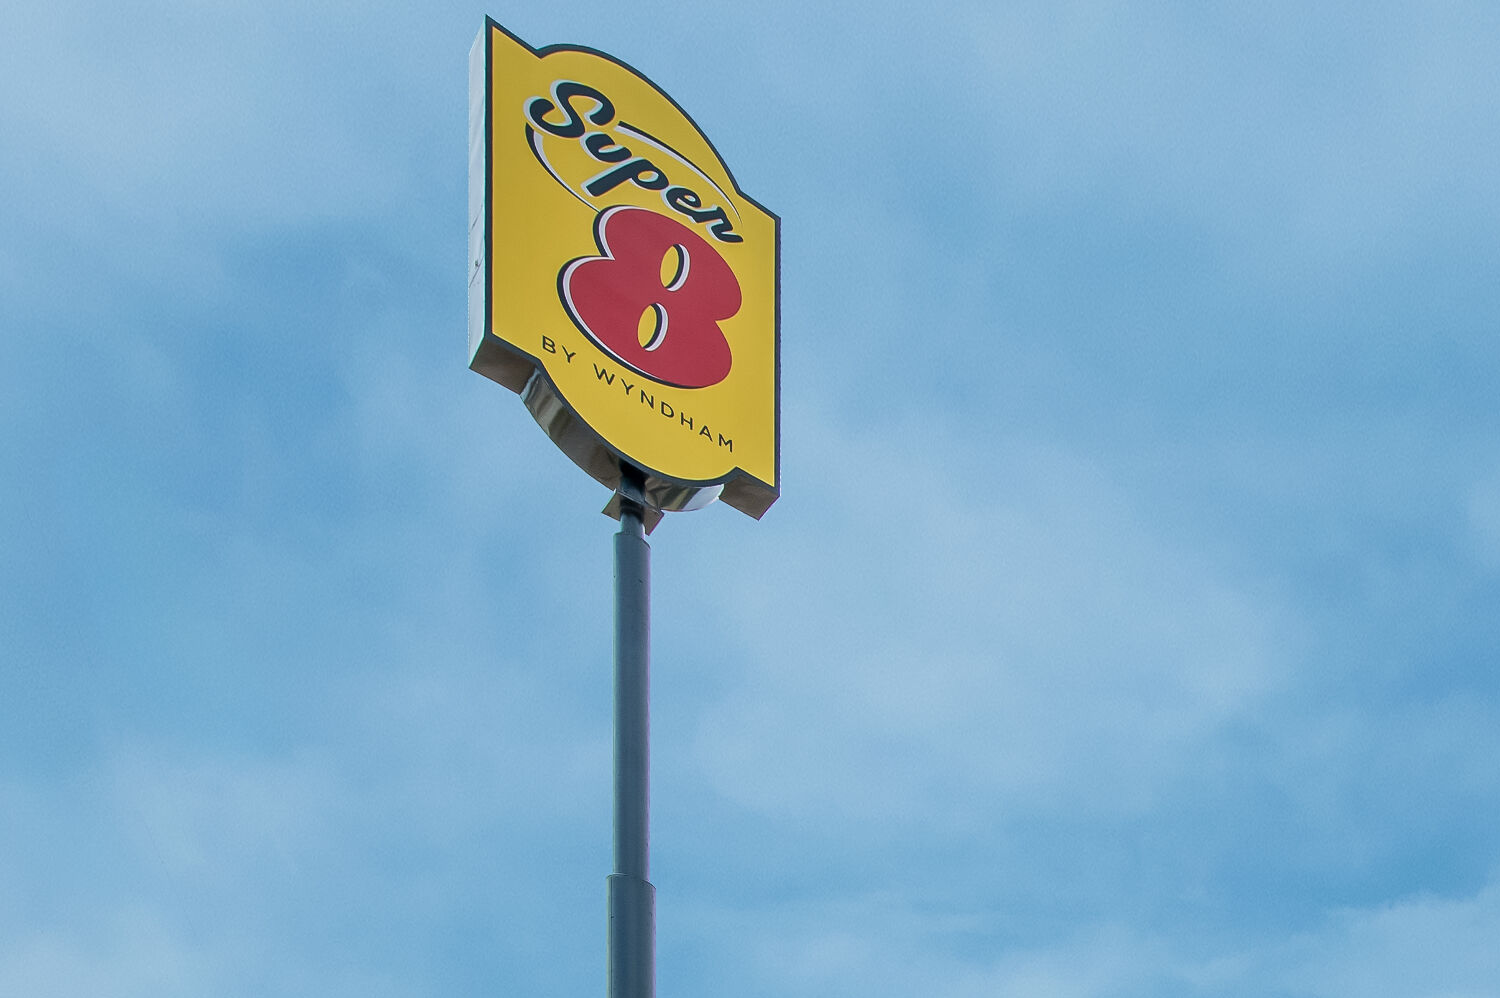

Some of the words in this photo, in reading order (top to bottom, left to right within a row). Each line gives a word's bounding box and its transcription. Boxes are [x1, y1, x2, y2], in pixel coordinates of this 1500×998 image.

[524, 80, 744, 244] Super
[557, 205, 743, 389] 8
[542, 334, 575, 364] BY
[593, 365, 734, 453] WYNDHAM
